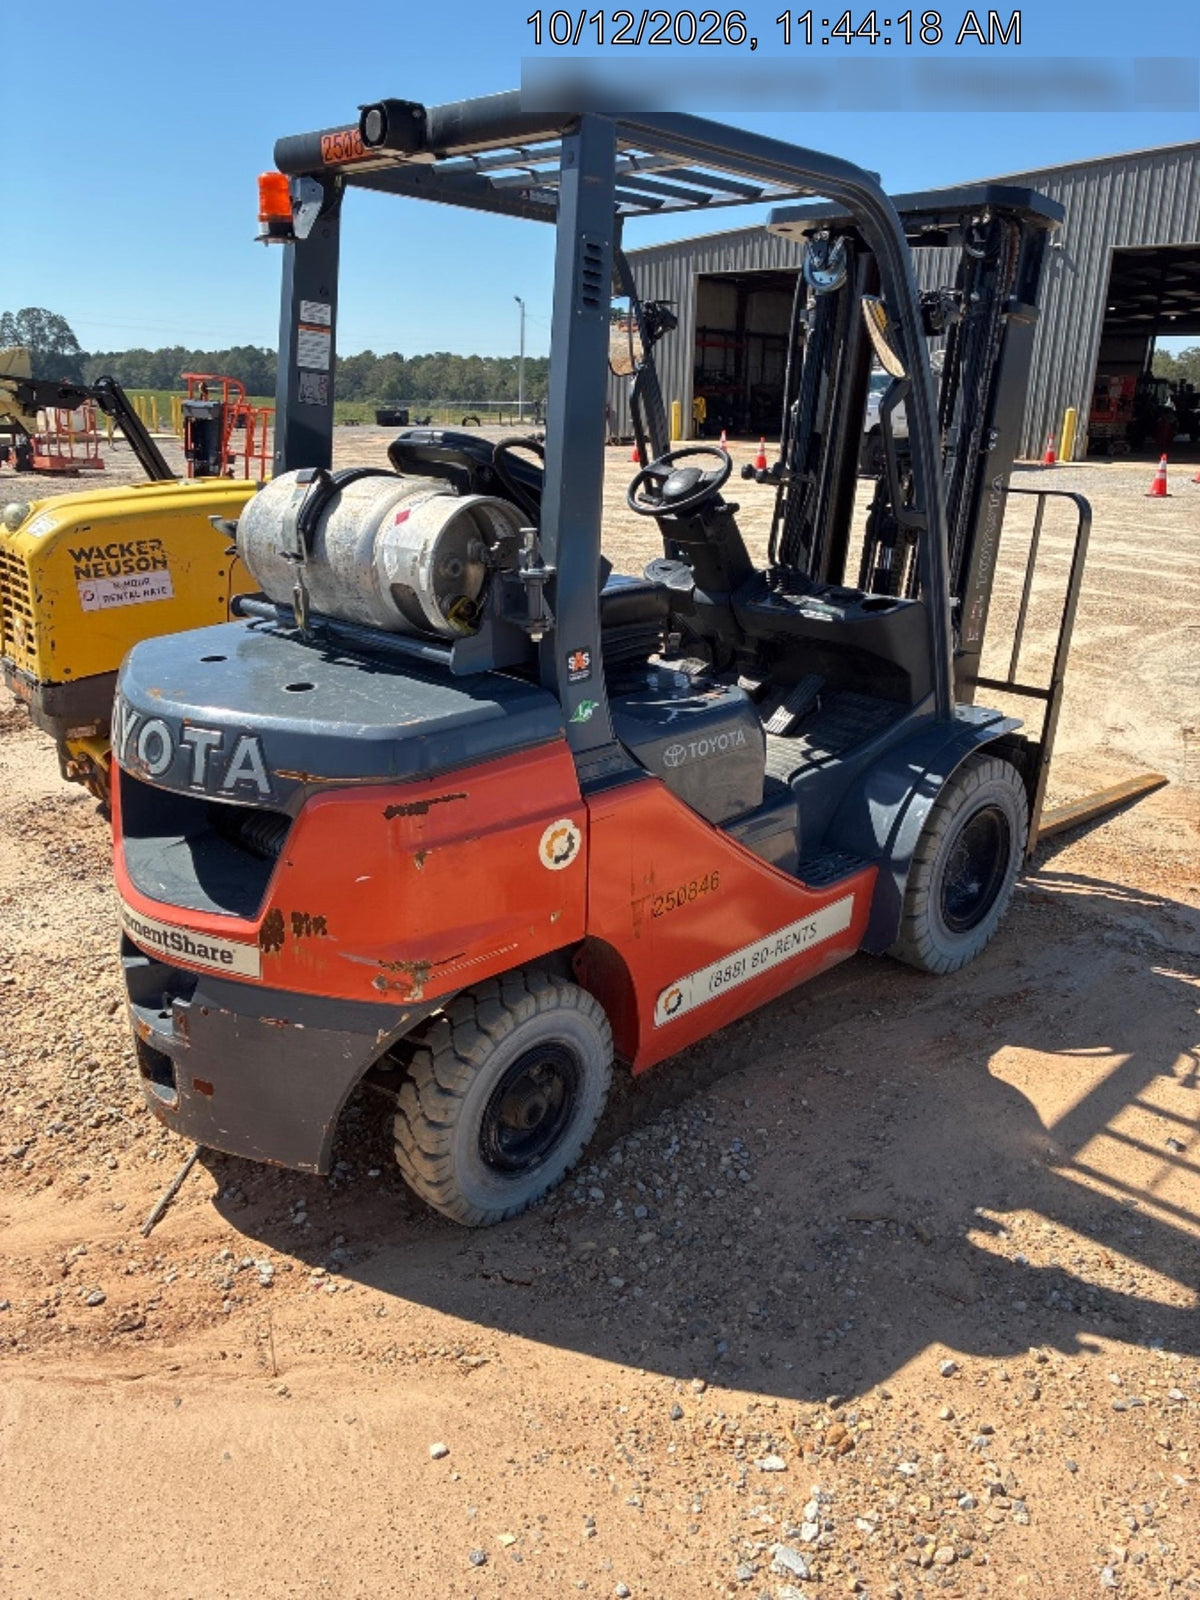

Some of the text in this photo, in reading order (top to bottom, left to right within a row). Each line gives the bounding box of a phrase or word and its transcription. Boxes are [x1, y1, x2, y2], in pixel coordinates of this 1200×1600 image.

[322, 130, 364, 161] 2508
[67, 538, 165, 562] WACKER
[74, 555, 168, 580] NEUSON
[112, 697, 272, 794] YOTA
[688, 729, 746, 758] TOYOTA
[652, 870, 720, 918] 250846
[124, 911, 234, 965] mentShare
[708, 921, 818, 993] (888) 80-RENTS
